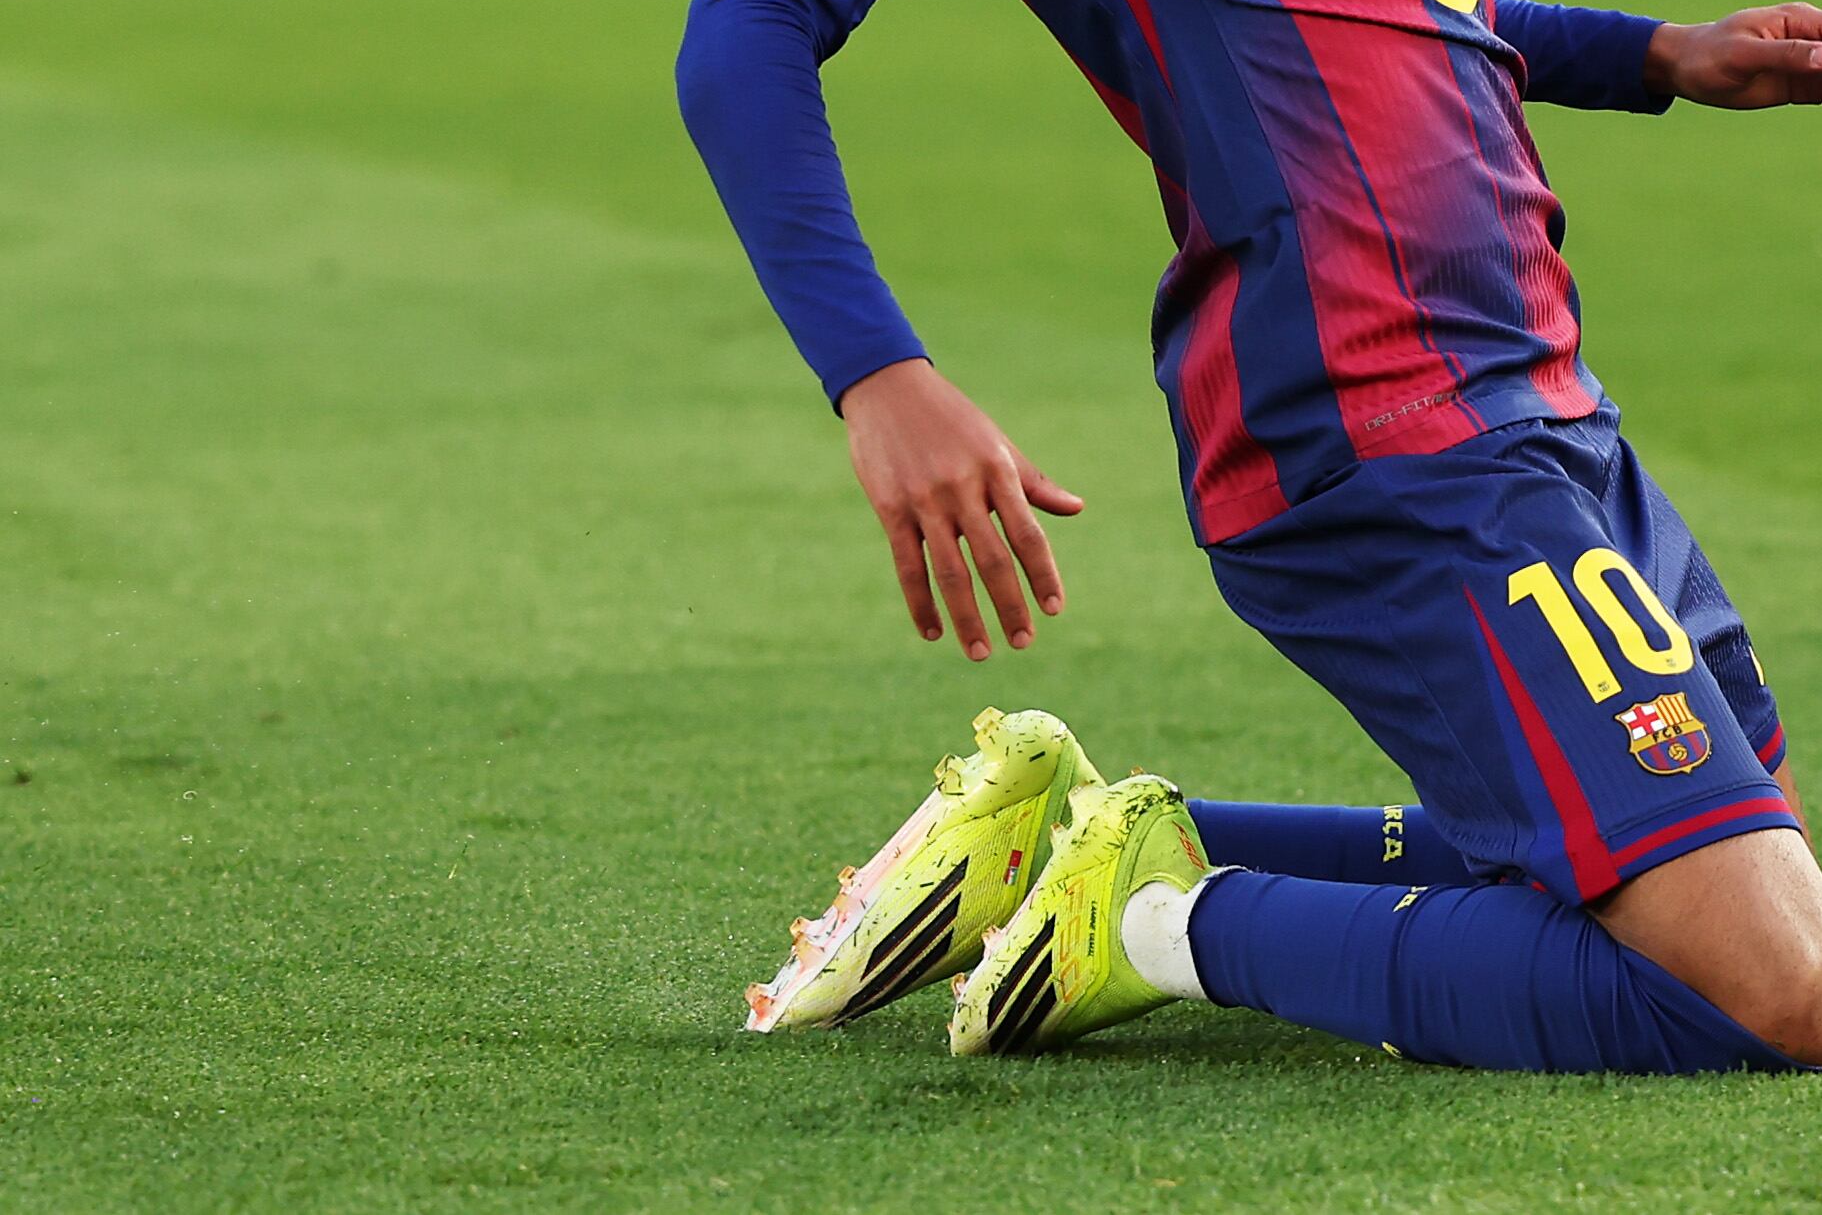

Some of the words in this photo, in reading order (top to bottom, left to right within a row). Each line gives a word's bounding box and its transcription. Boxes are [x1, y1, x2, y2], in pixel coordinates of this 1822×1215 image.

[1508, 547, 1695, 704] 10
[1652, 724, 1682, 743] FCB
[1382, 804, 1403, 863] RÇA
